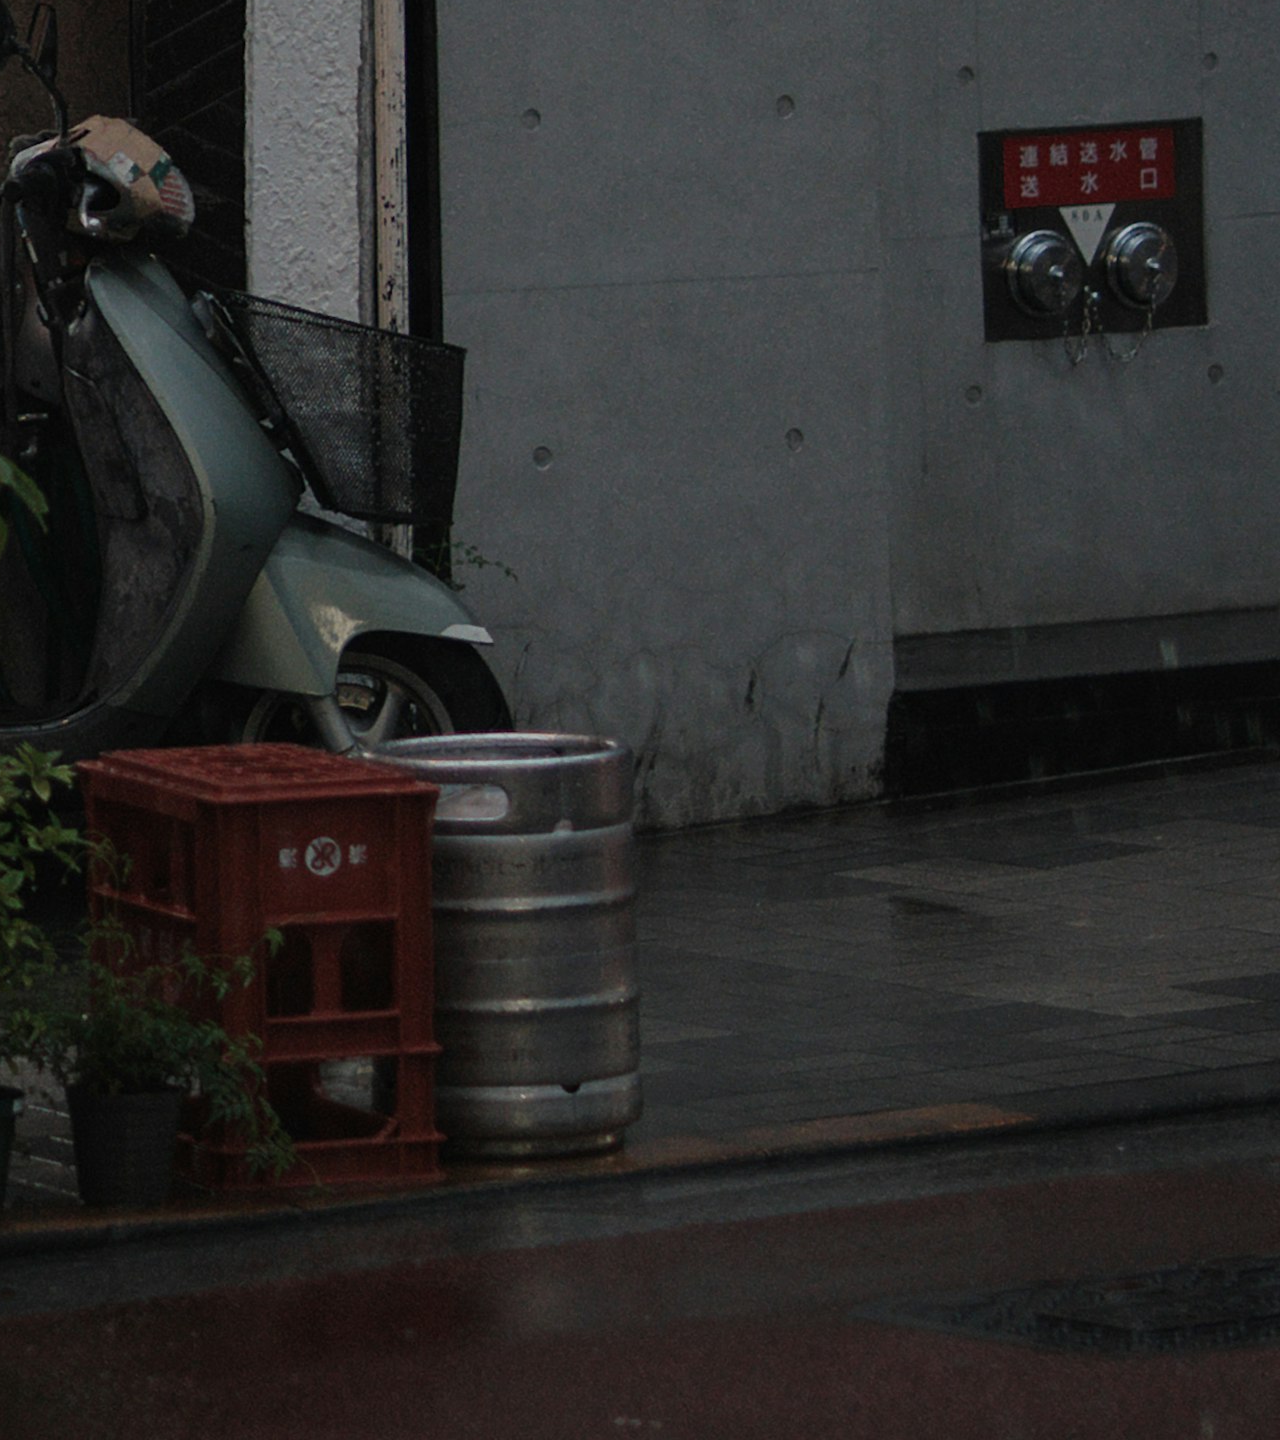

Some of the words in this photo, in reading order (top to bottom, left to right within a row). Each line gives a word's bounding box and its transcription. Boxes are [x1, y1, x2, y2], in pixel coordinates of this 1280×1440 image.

[1019, 137, 1159, 169] 連結送水管
[1019, 168, 1159, 198] 送水口
